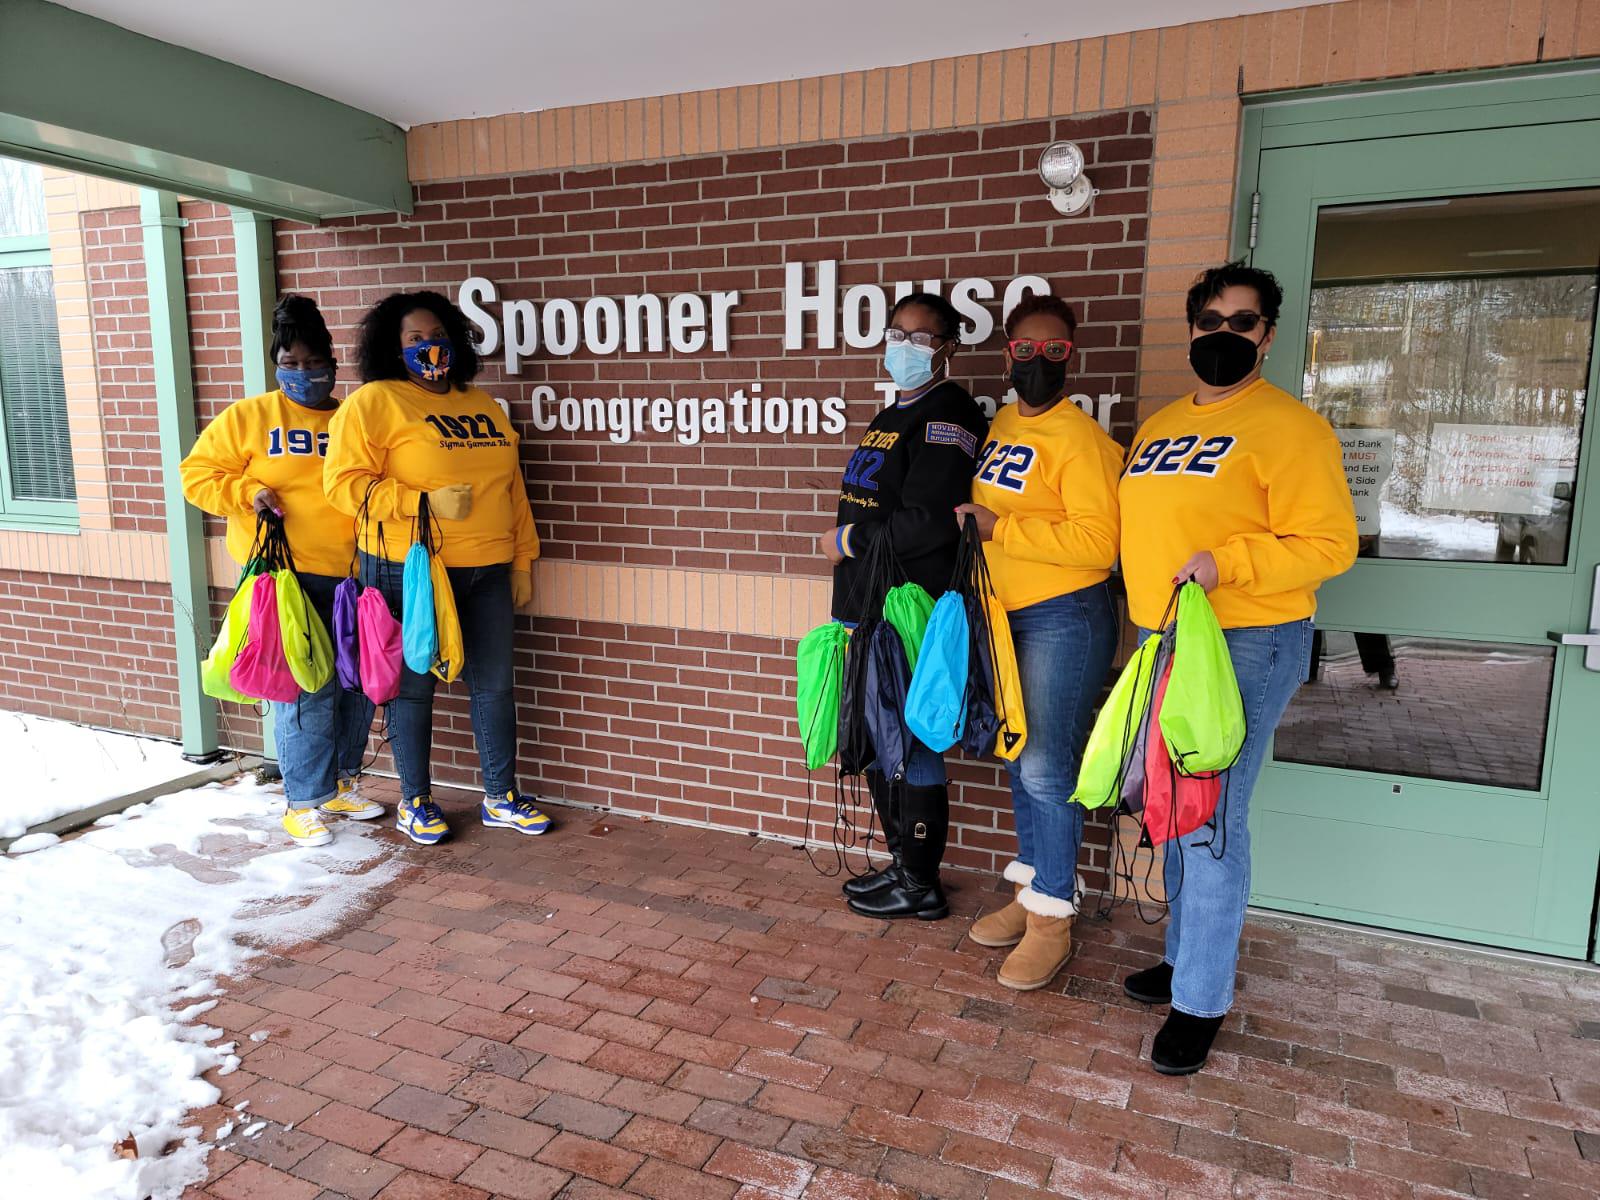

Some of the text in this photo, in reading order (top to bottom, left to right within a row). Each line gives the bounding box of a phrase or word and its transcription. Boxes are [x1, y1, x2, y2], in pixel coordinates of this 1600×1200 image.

[458, 277, 741, 375] Spooner
[531, 383, 848, 446] Congregations
[425, 413, 505, 440] 1922
[1358, 440, 1382, 448] Bank
[1348, 452, 1377, 460] MUST
[1362, 464, 1380, 473] Exit
[1355, 476, 1376, 485] Side
